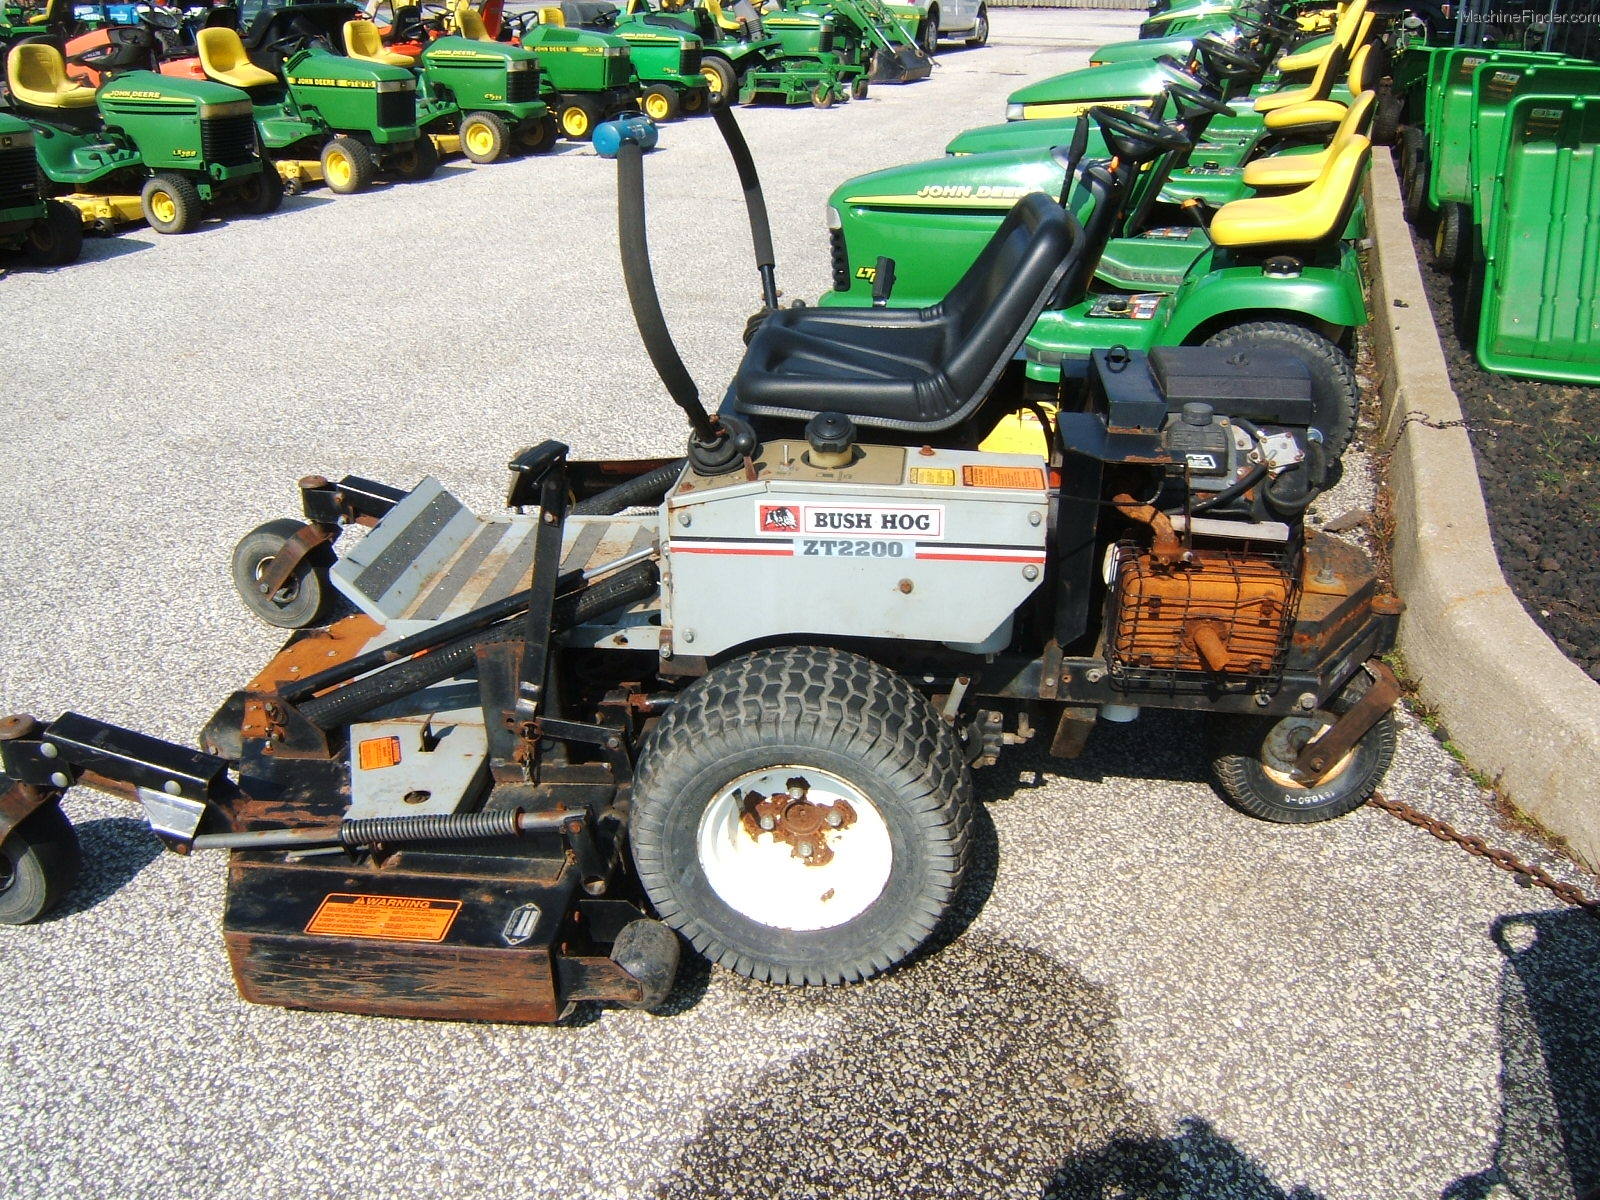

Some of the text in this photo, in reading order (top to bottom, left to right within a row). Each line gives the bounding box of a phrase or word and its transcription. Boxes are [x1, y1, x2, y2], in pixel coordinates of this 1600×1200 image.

[110, 90, 161, 99] JOHN DEERE
[917, 185, 973, 198] JOHN
[814, 512, 930, 530] BUSH HOG
[803, 539, 903, 558] ZT2200
[366, 896, 431, 909] WARNING
